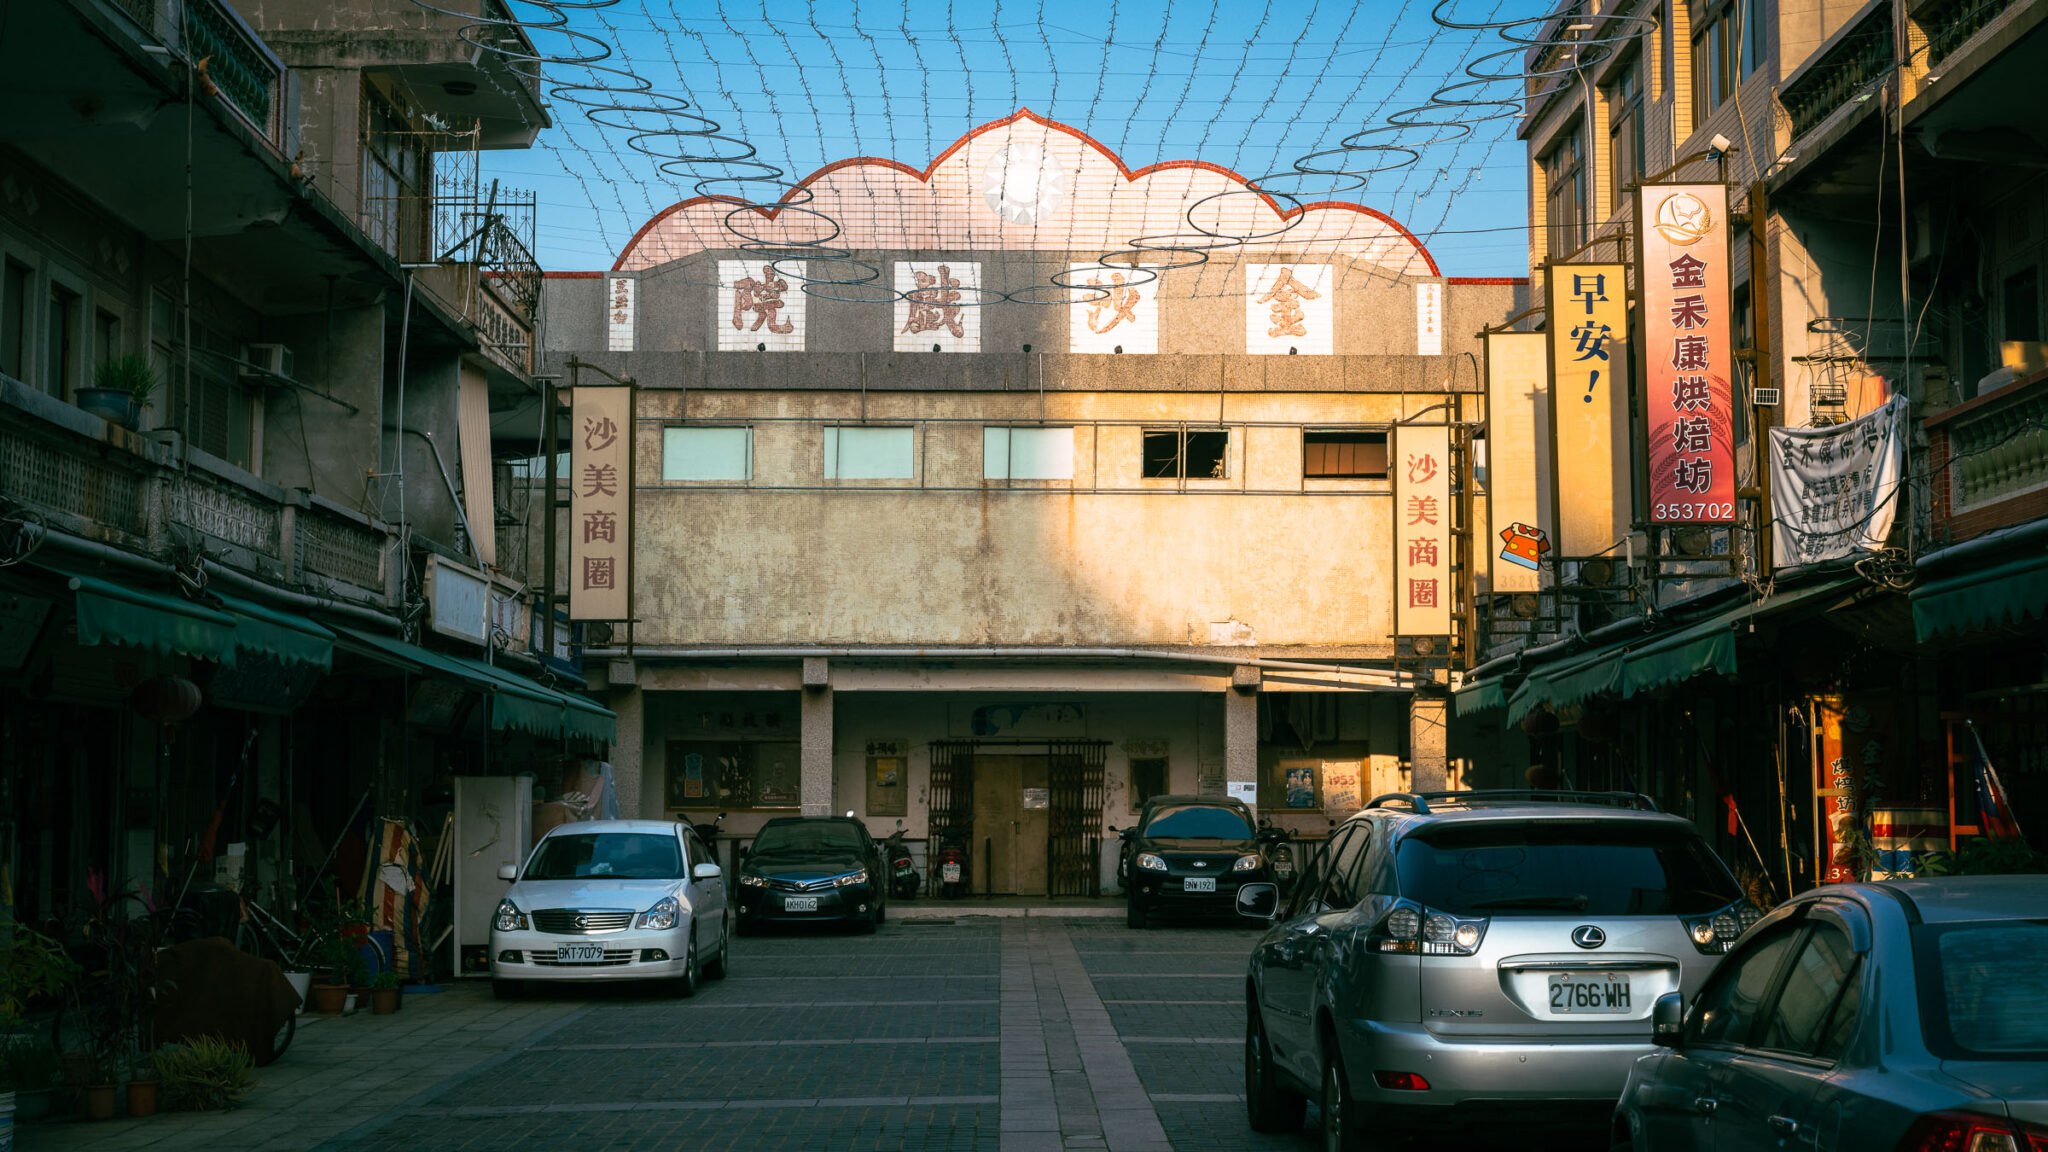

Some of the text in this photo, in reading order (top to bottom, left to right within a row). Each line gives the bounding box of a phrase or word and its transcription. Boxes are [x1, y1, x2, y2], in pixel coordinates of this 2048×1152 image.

[1669, 253, 1712, 494] 金禾康烘焙坊
[583, 417, 617, 590] 沙美商圈
[1655, 503, 1733, 519] 353702
[1407, 453, 1439, 608] 沙美商圈
[1328, 775, 1355, 786] 1953
[785, 899, 817, 910] AKH-0162
[558, 946, 603, 960] BKT-7079
[1550, 982, 1631, 1008] 2766-WH
